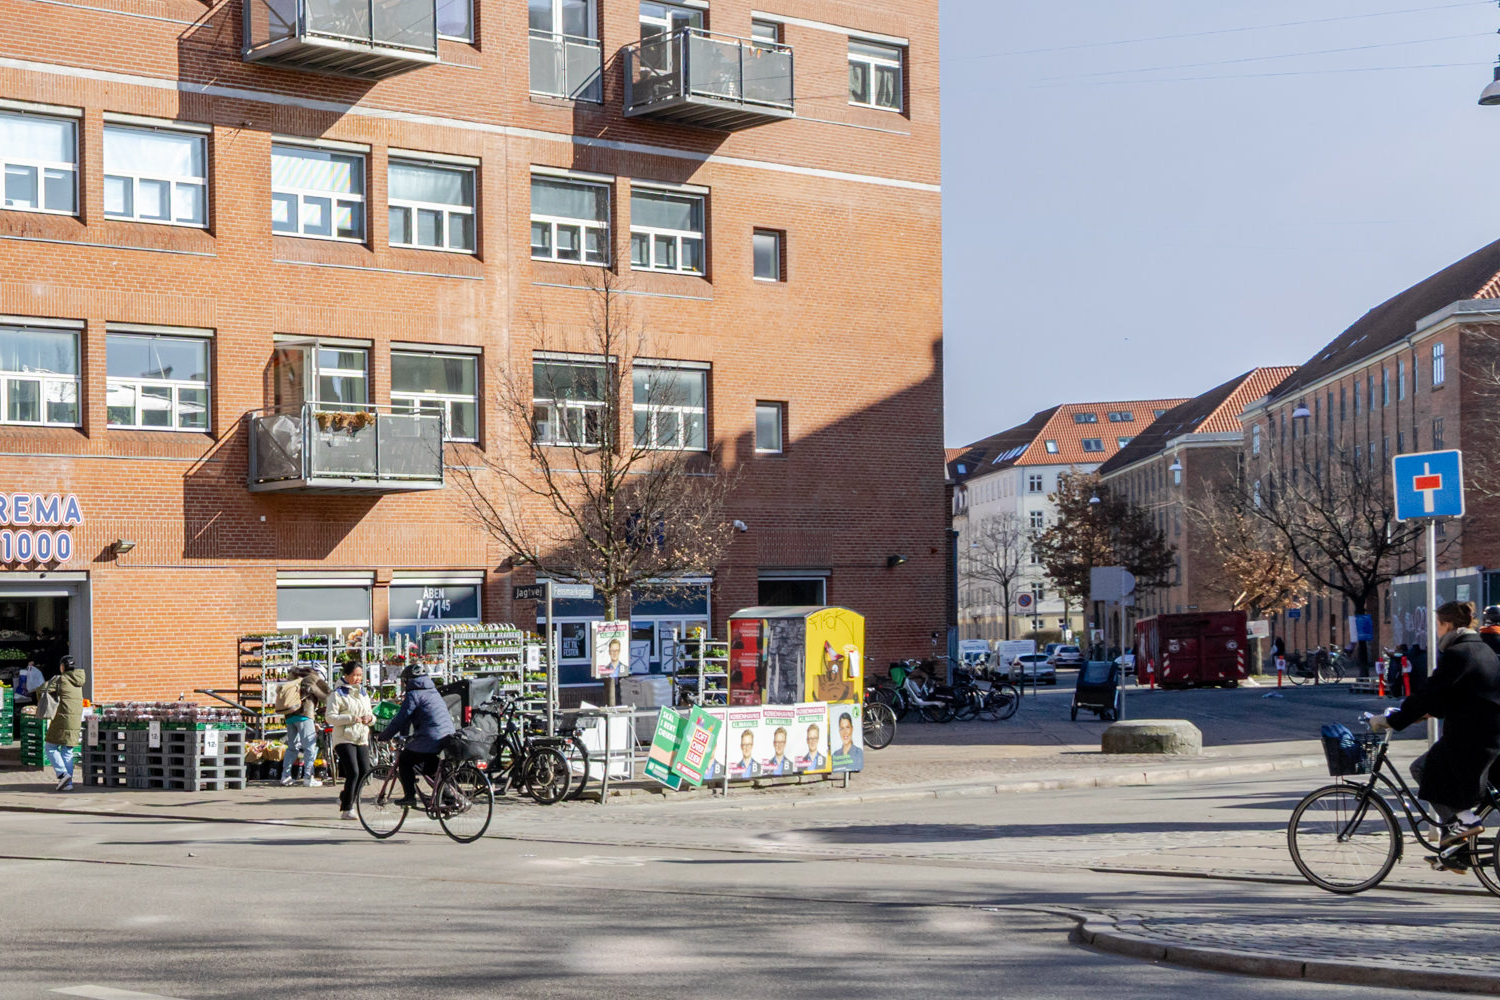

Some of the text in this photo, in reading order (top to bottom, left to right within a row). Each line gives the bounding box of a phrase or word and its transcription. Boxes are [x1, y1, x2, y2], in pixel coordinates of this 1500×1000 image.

[0, 529, 74, 563] 1000
[423, 586, 445, 599] ÅBEN
[516, 587, 542, 599] Jagtvej
